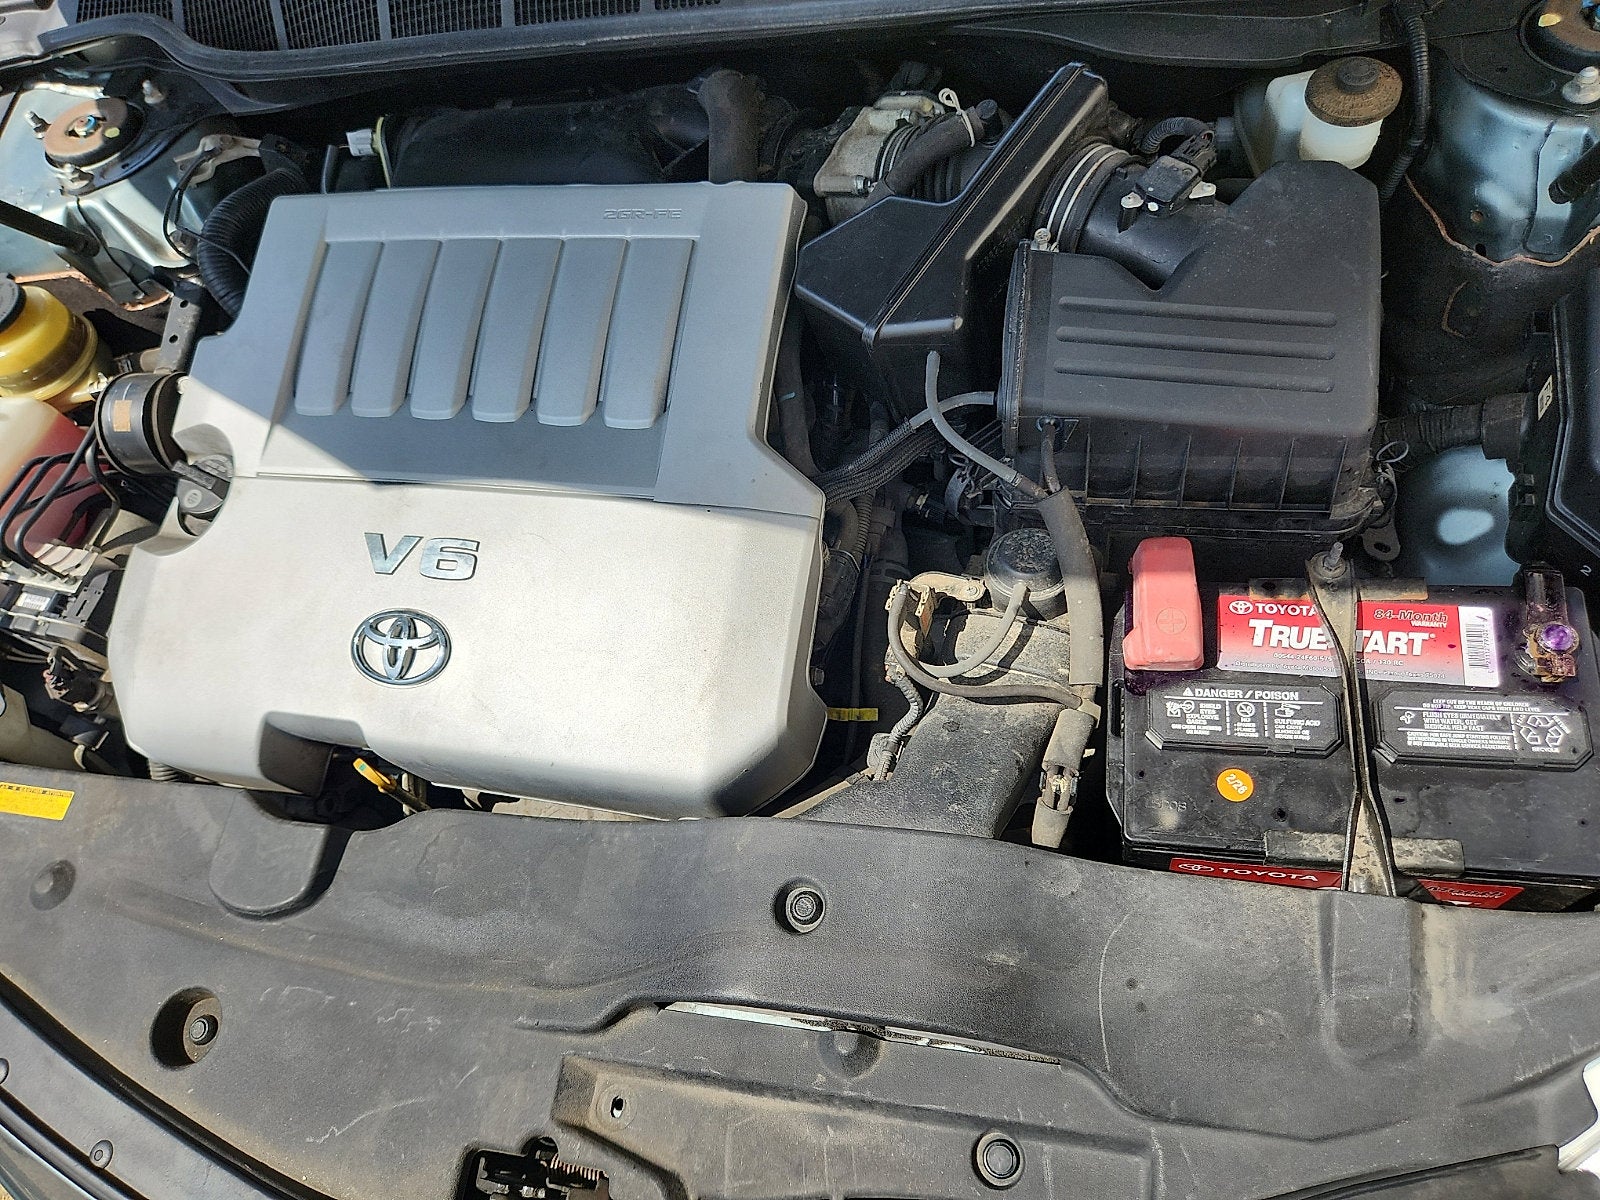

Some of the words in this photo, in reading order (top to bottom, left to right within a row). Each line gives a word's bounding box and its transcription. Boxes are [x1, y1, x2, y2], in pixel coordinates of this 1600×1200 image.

[603, 208, 682, 220] 2GR-FE
[364, 532, 480, 581] V6
[1374, 608, 1448, 622] 84-Month
[1411, 620, 1447, 628] WARRANTY
[1218, 867, 1318, 882] TOYOTA
